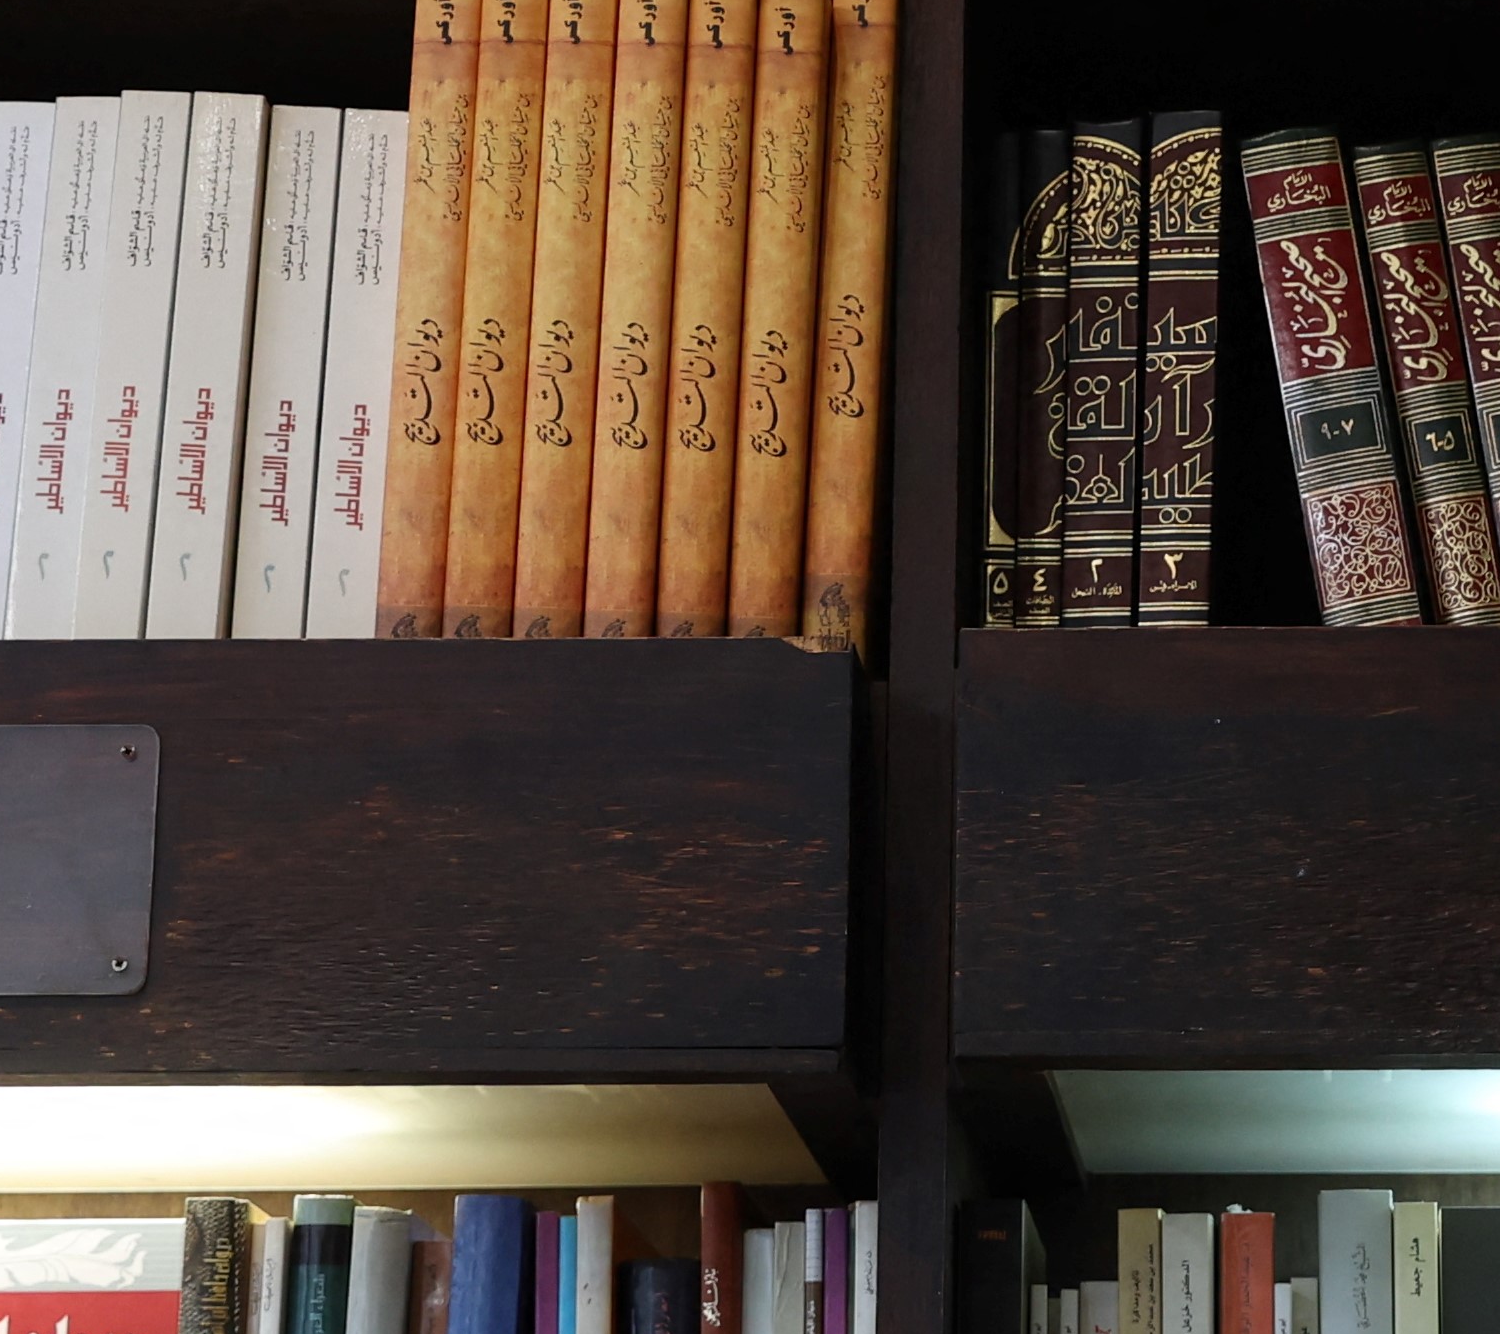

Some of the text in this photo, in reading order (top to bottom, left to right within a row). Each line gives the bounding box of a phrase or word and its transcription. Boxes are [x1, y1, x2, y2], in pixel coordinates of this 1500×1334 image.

[611, 321, 649, 376] ديوان
[182, 385, 216, 441] ديوان
[338, 402, 372, 458] ديوان
[993, 571, 1009, 594] ٥
[1032, 568, 1048, 592] ٤
[1163, 551, 1184, 580] ٣
[1180, 1258, 1193, 1303] الدكتور
[1408, 1236, 1426, 1297] هشام جعيط
